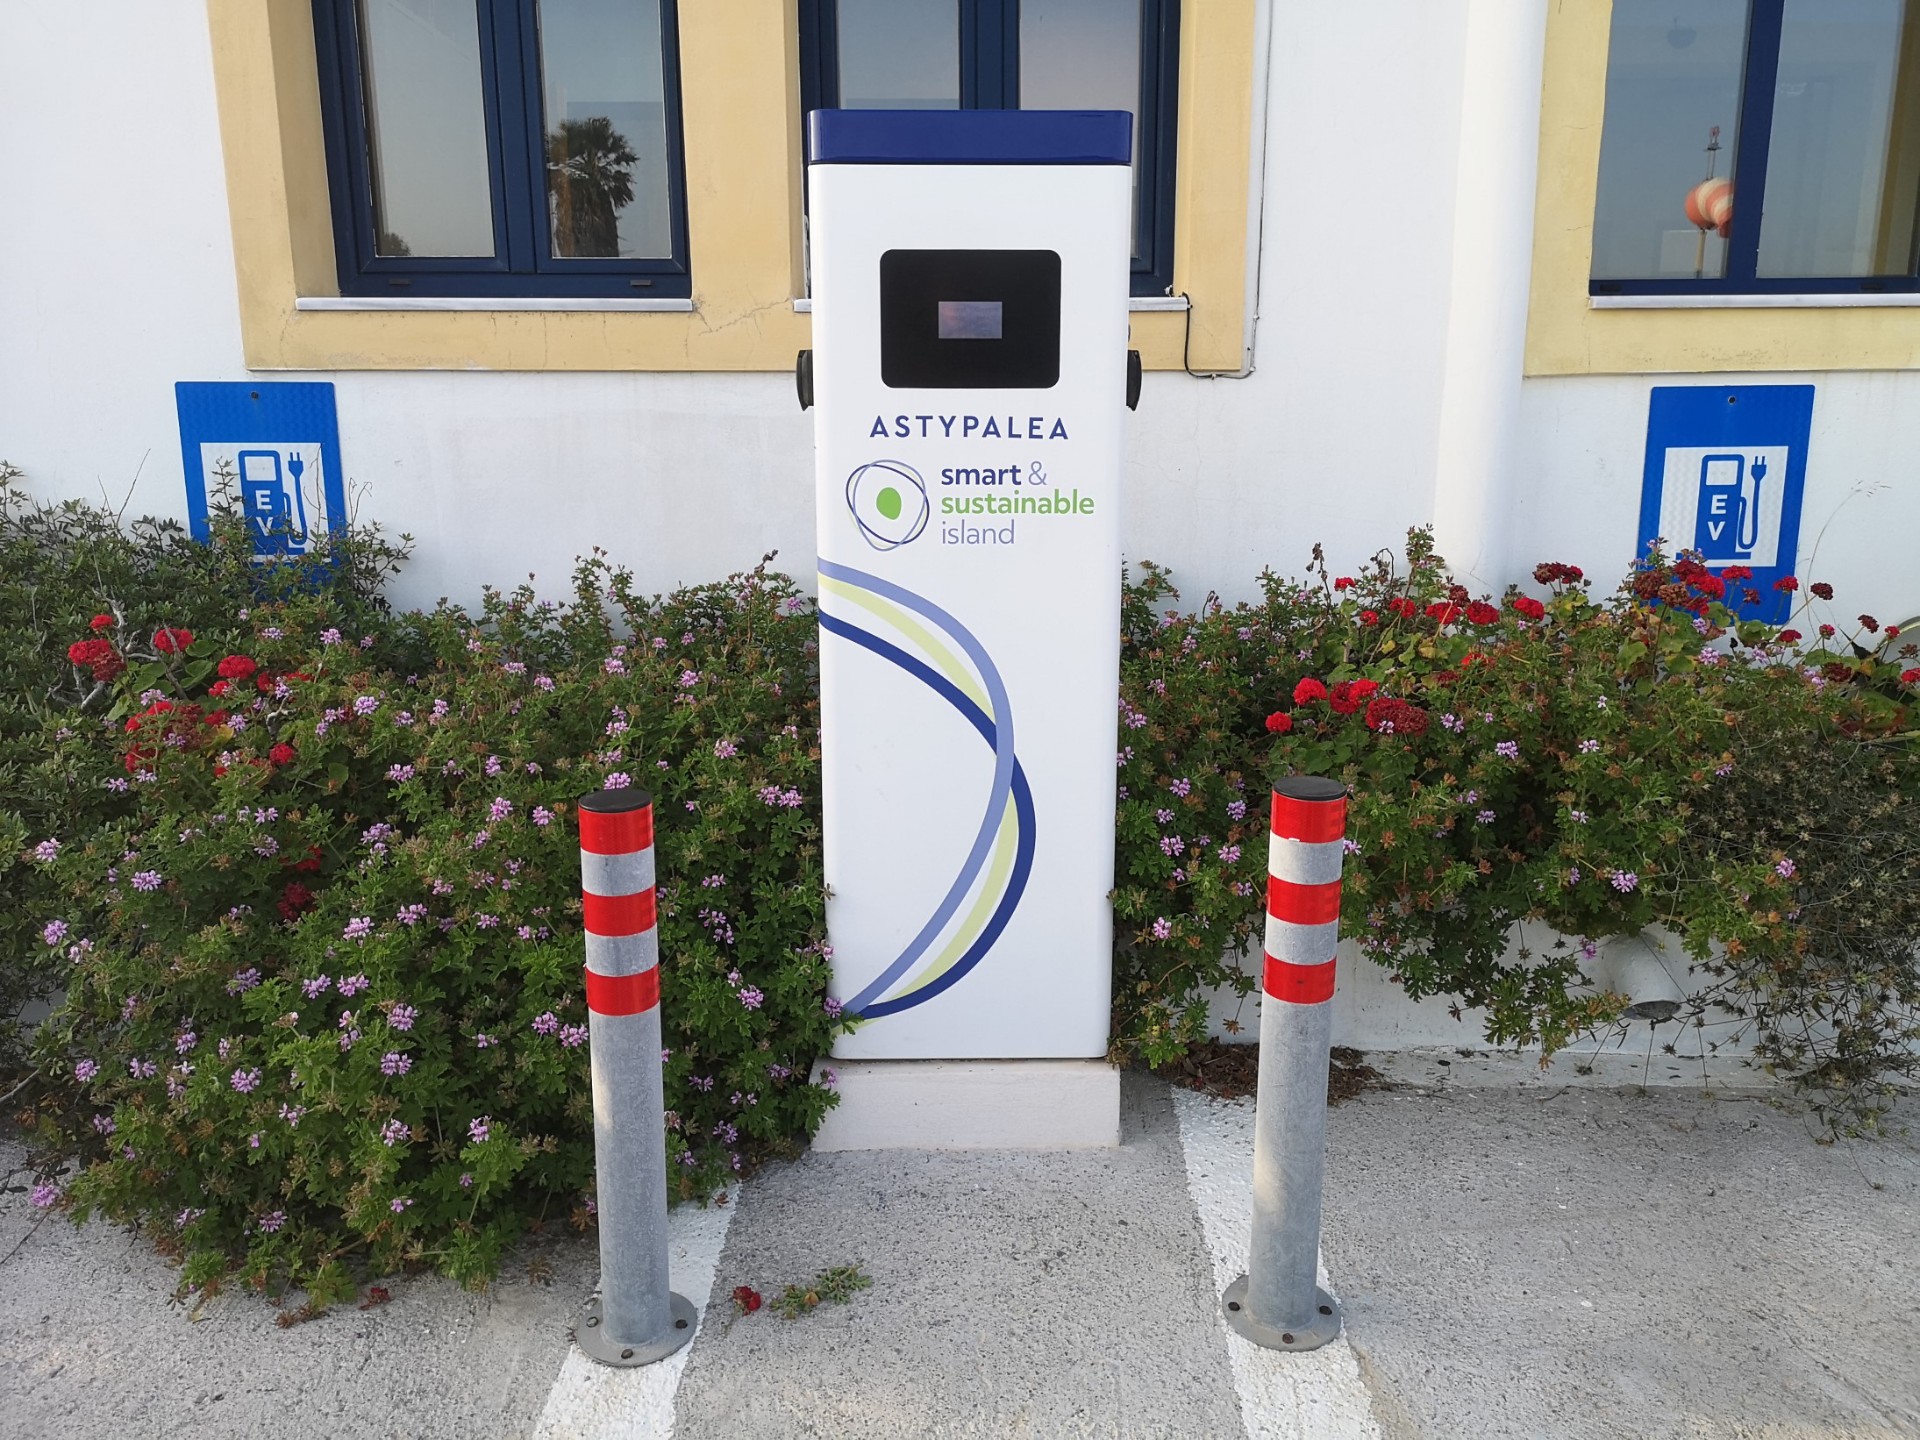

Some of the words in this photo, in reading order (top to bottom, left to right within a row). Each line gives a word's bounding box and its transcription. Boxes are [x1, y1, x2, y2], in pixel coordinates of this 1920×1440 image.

[869, 415, 1068, 439] ASTYPALEA
[941, 464, 1021, 485] smart
[1028, 461, 1047, 485] &
[941, 489, 1094, 514] sustainable
[941, 519, 1015, 545] island
